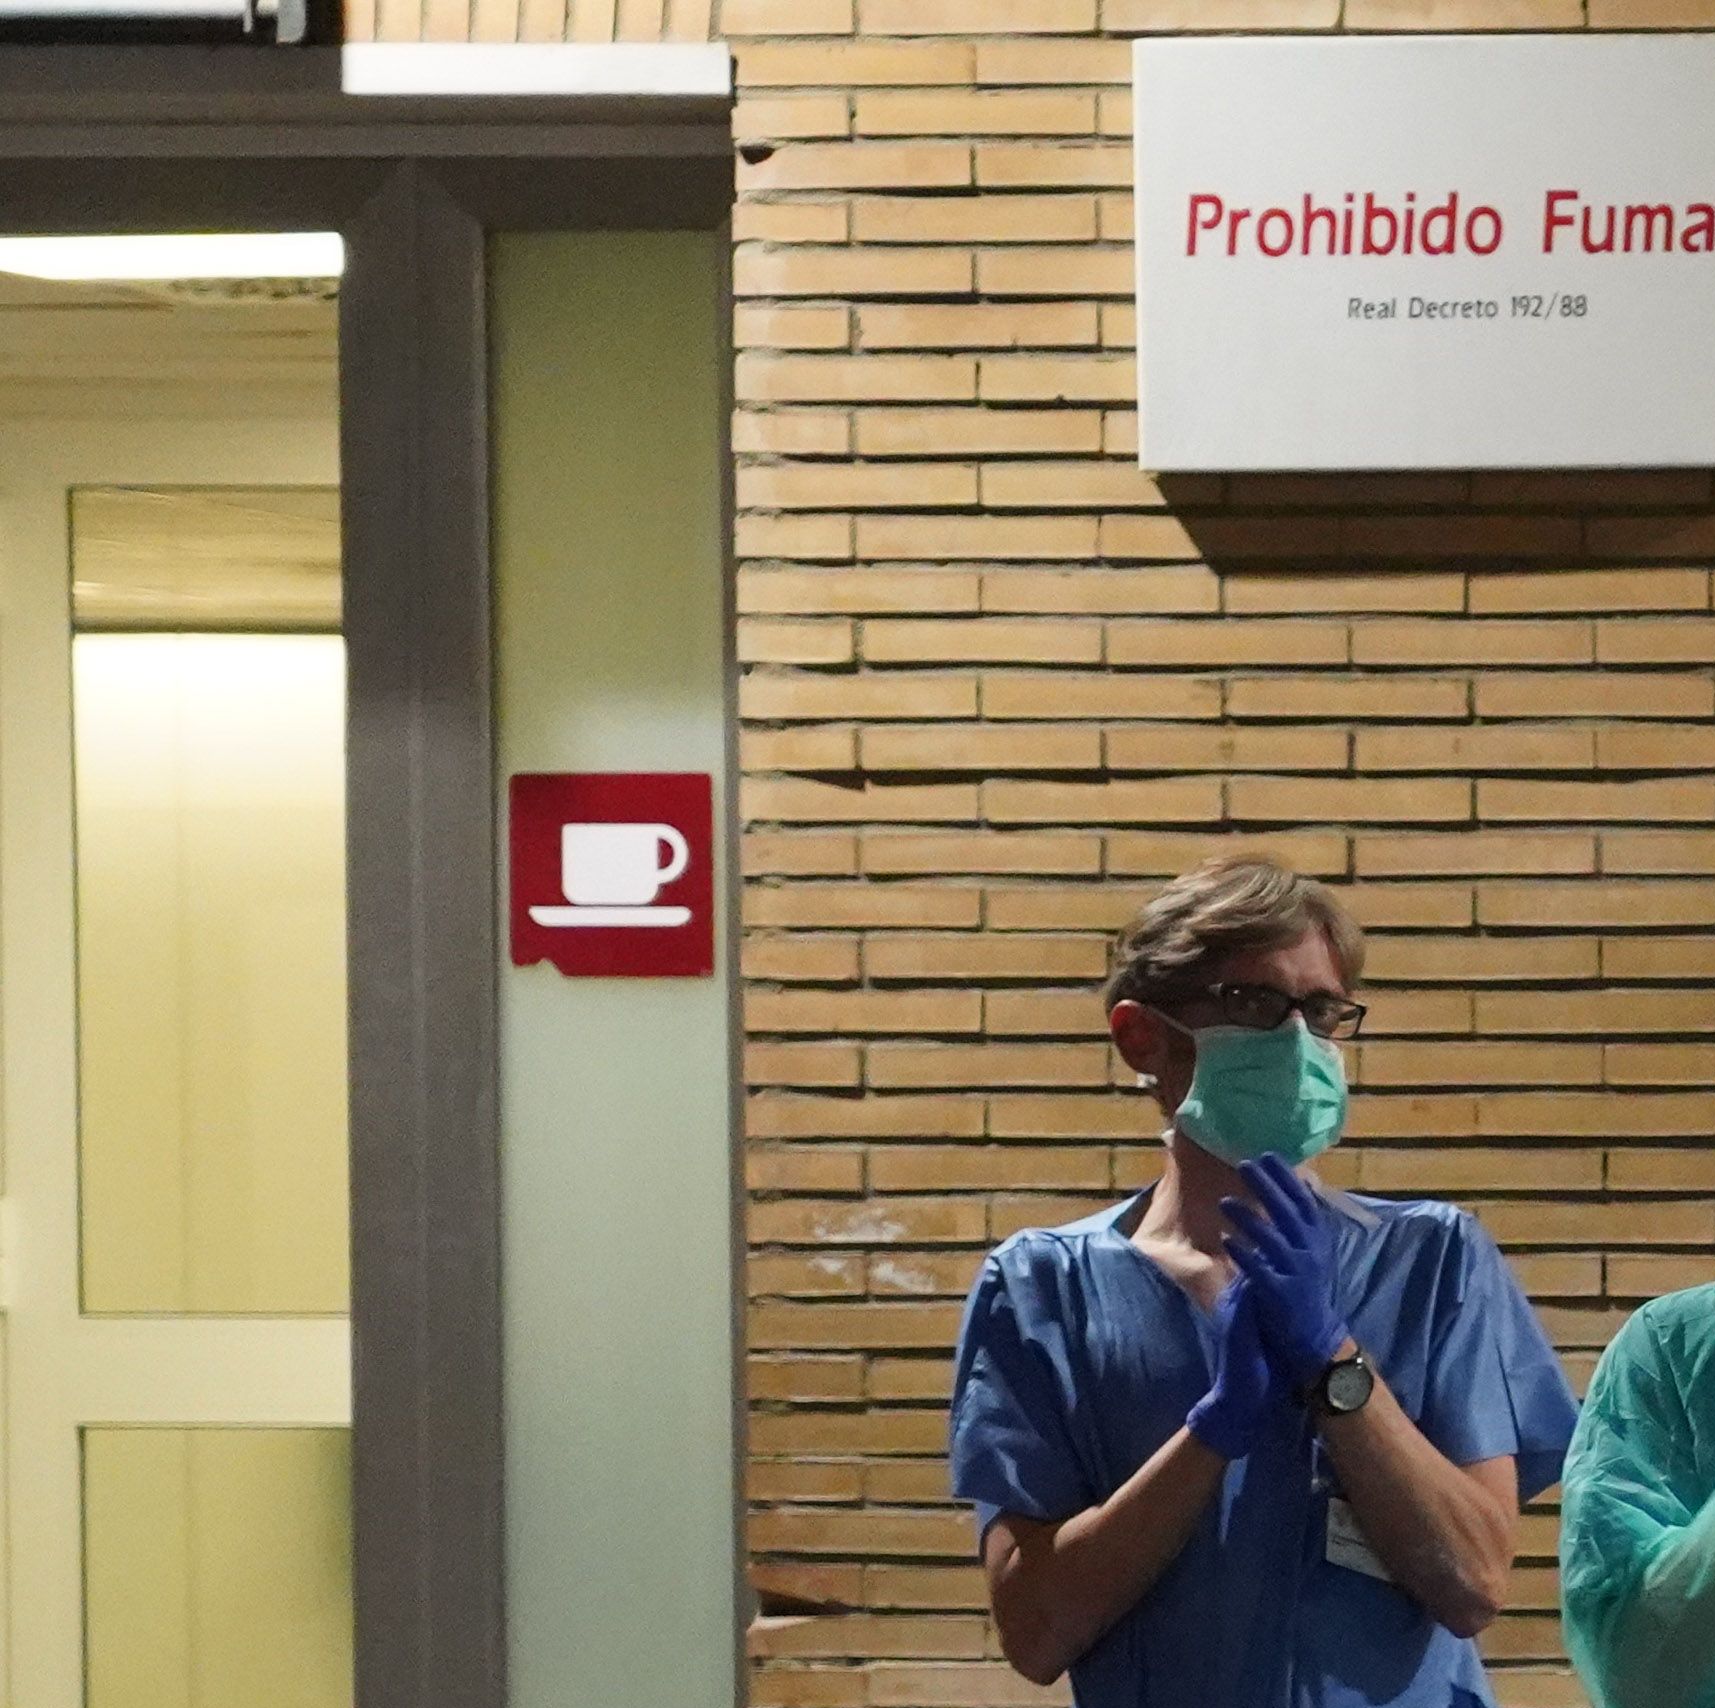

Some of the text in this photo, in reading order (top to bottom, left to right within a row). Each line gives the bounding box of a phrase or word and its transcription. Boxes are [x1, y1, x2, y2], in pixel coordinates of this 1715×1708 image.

[1185, 191, 1504, 260] Prohibido
[1348, 292, 1590, 321] Real Decreto 192/88
